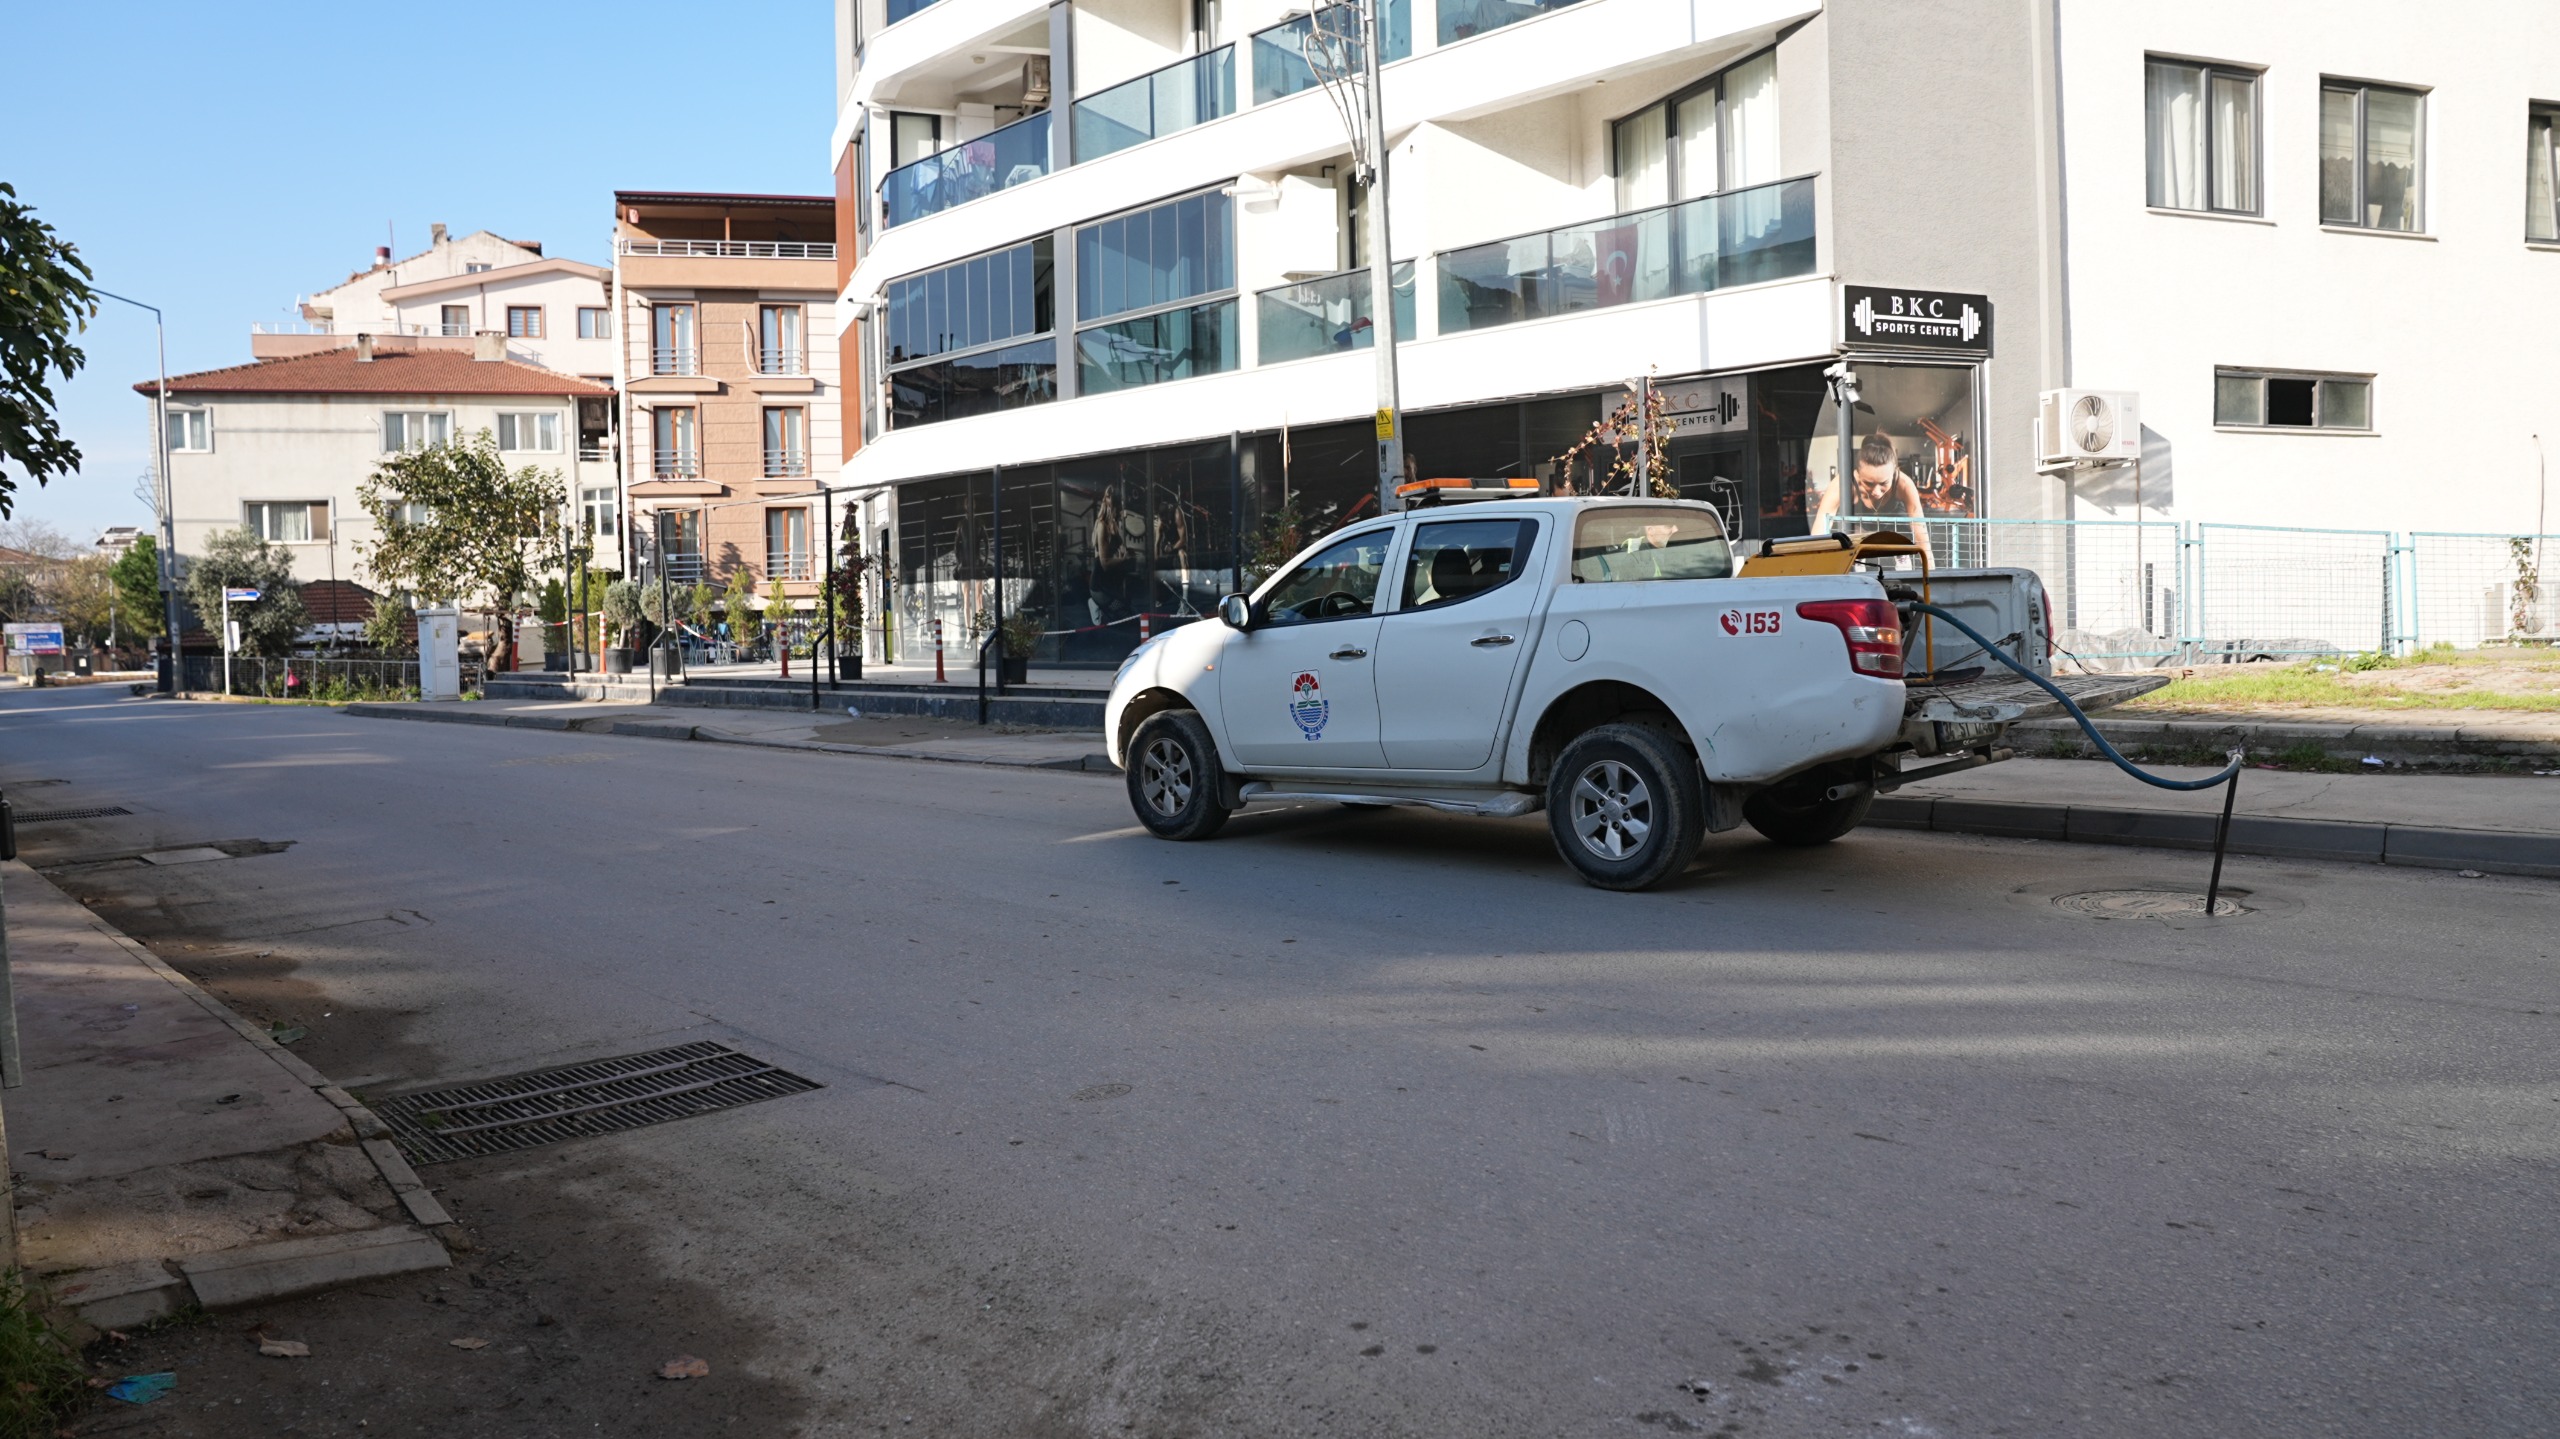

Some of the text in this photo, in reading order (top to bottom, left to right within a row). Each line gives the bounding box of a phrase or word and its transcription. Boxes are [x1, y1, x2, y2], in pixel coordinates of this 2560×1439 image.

[1891, 296, 1943, 318] BKC
[1876, 322, 1959, 337] SPORTS CENTER
[1745, 611, 1780, 634] 153
